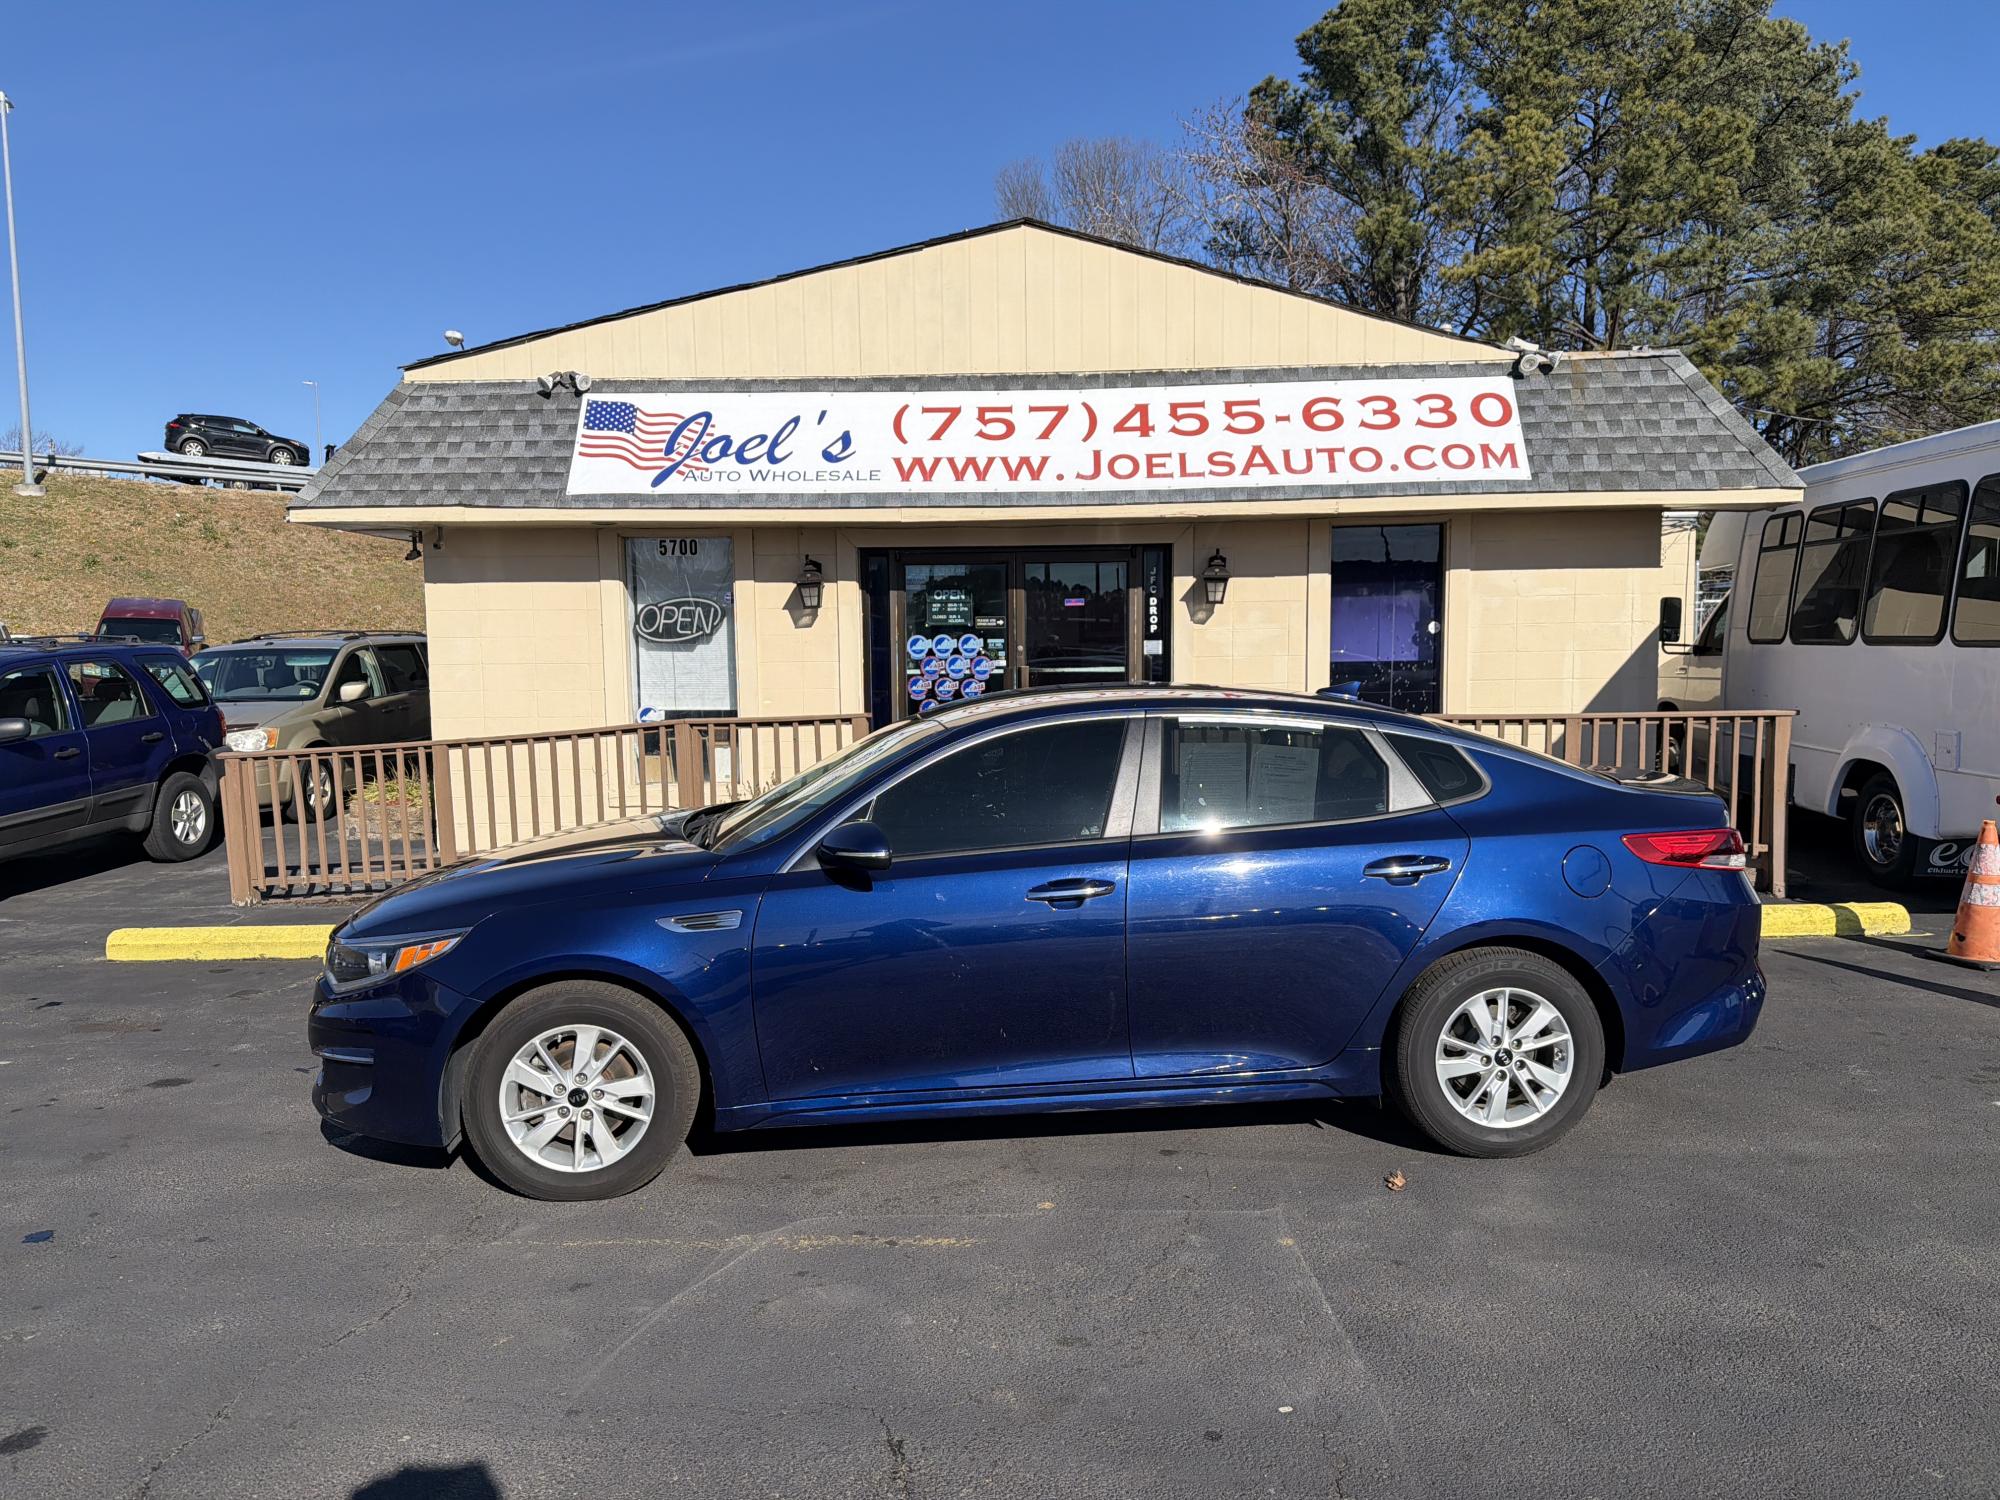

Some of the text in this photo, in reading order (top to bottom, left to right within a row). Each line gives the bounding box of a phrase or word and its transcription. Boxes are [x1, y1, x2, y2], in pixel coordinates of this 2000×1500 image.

[651, 410, 856, 488] Joel's
[682, 468, 881, 482] AUTO WHOLESALE
[659, 539, 698, 556] 5700
[933, 589, 966, 600] OPEN
[640, 605, 715, 634] OPEN
[1149, 597, 1158, 633] DROP
[569, 1093, 587, 1104] KIA
